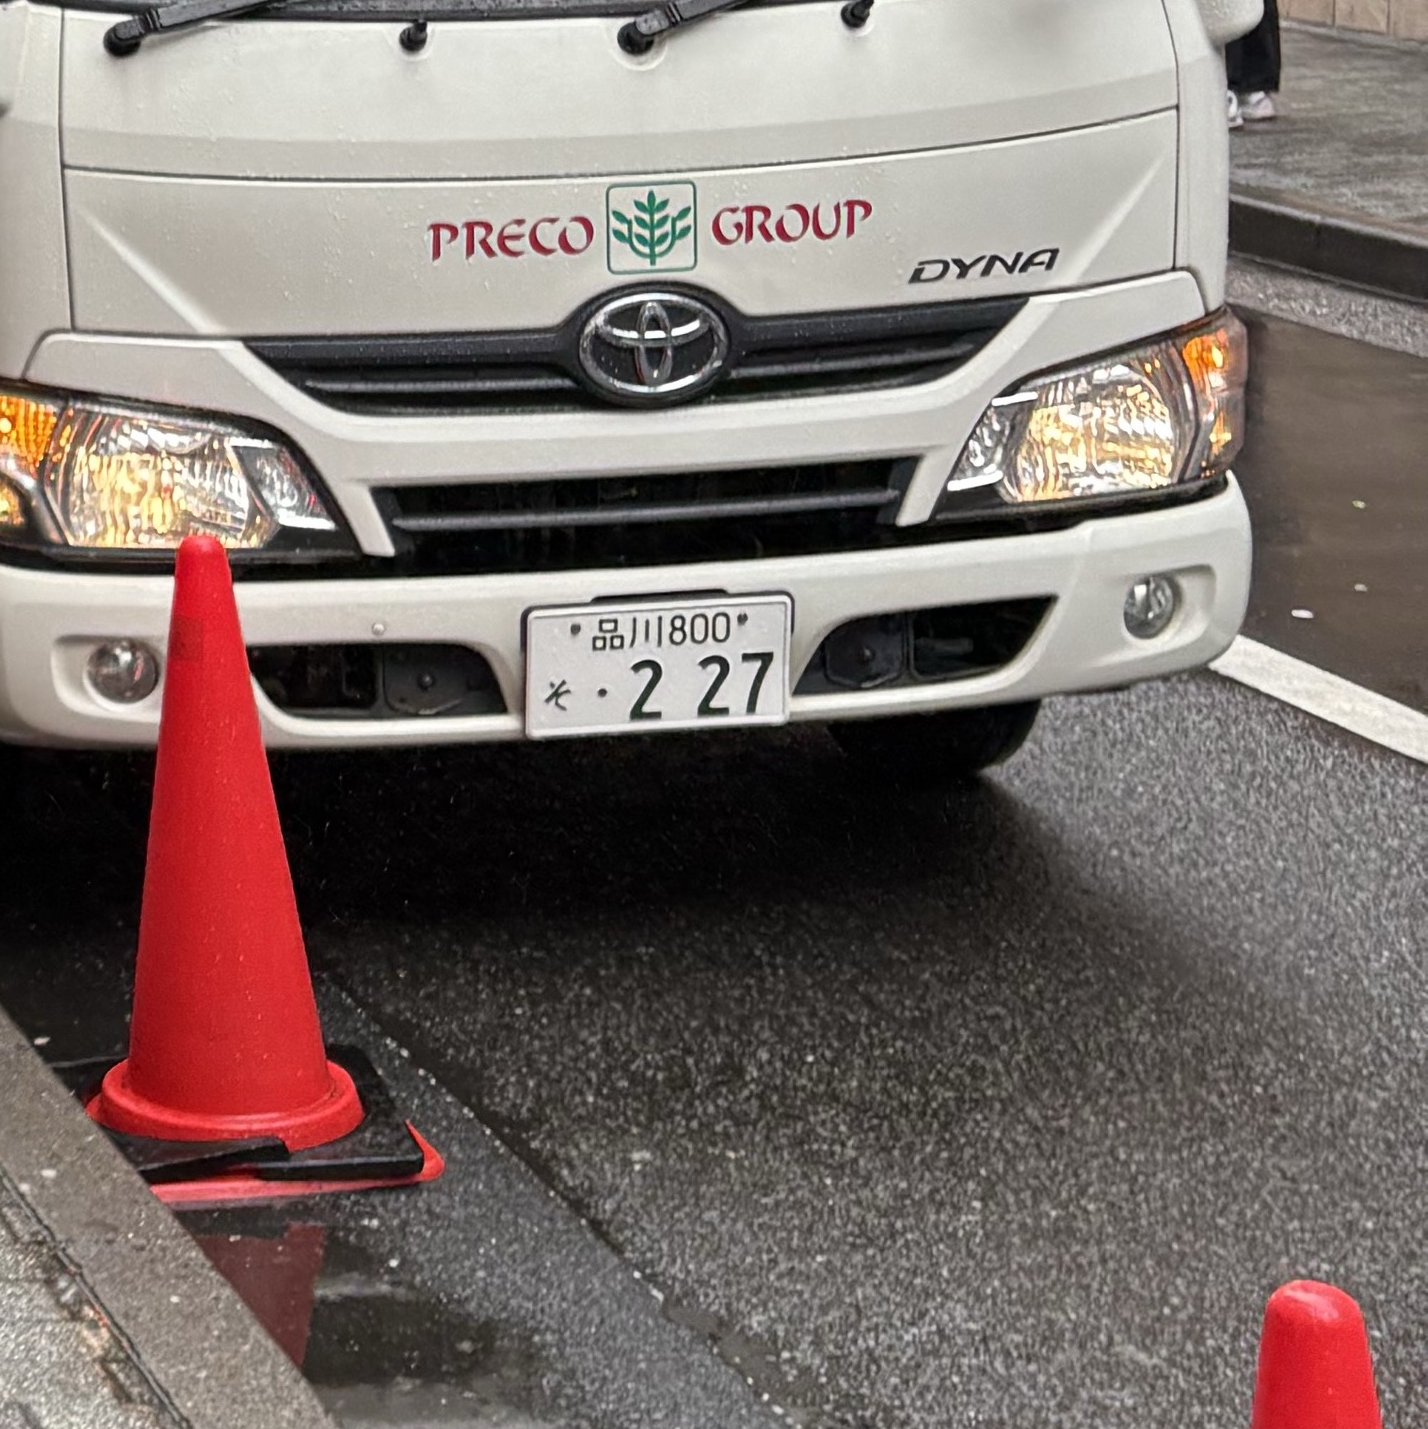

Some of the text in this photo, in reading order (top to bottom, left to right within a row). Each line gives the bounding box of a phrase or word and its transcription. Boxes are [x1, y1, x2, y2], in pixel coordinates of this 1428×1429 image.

[428, 198, 874, 263] PRECO GROUP
[908, 246, 1061, 285] DYNA
[592, 610, 732, 653] 品川800
